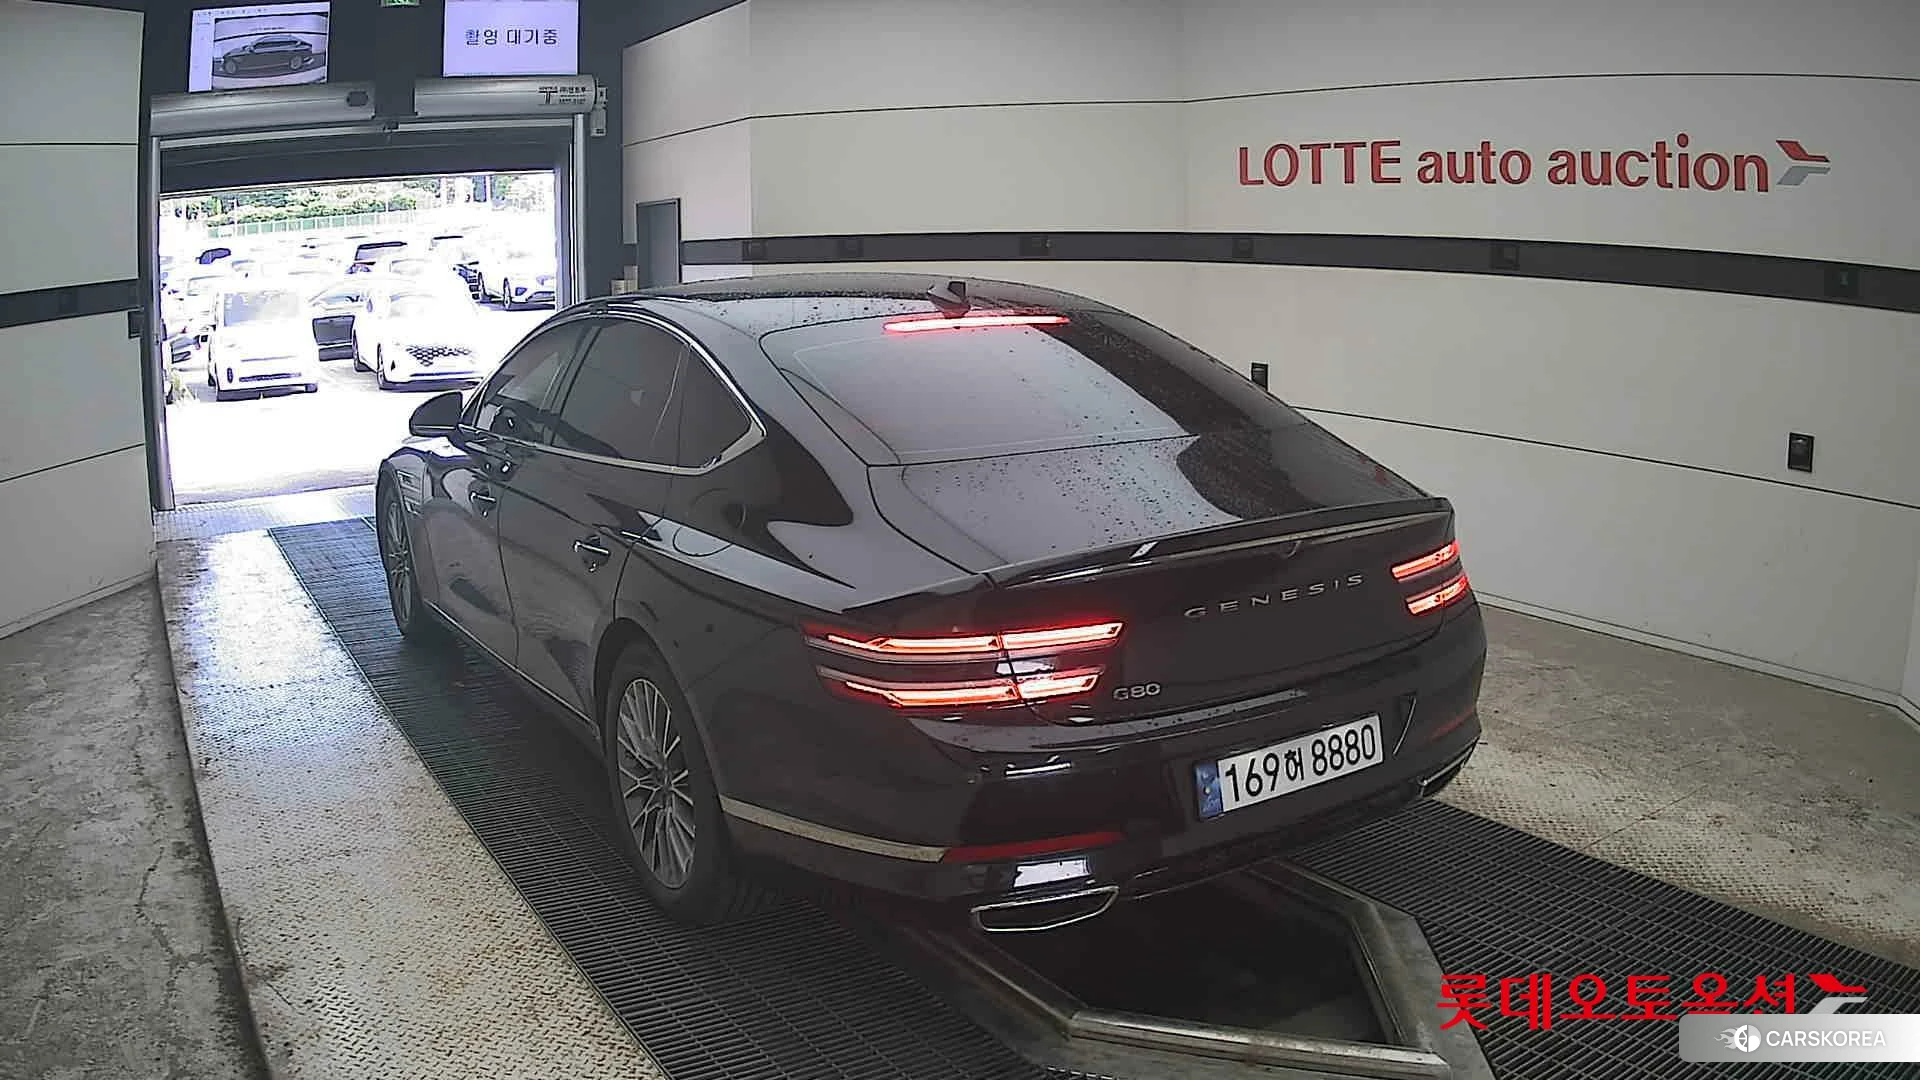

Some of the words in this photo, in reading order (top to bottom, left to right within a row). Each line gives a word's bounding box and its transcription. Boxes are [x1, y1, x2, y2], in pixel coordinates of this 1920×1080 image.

[506, 29, 558, 46] 대기중
[1239, 140, 1401, 187] LOTTE
[1417, 141, 1532, 185] auto
[1547, 133, 1769, 192] auction
[1184, 574, 1363, 618] GENESIS
[1113, 683, 1160, 700] G80
[1225, 747, 1305, 802] 169허
[1311, 724, 1376, 776] 8880
